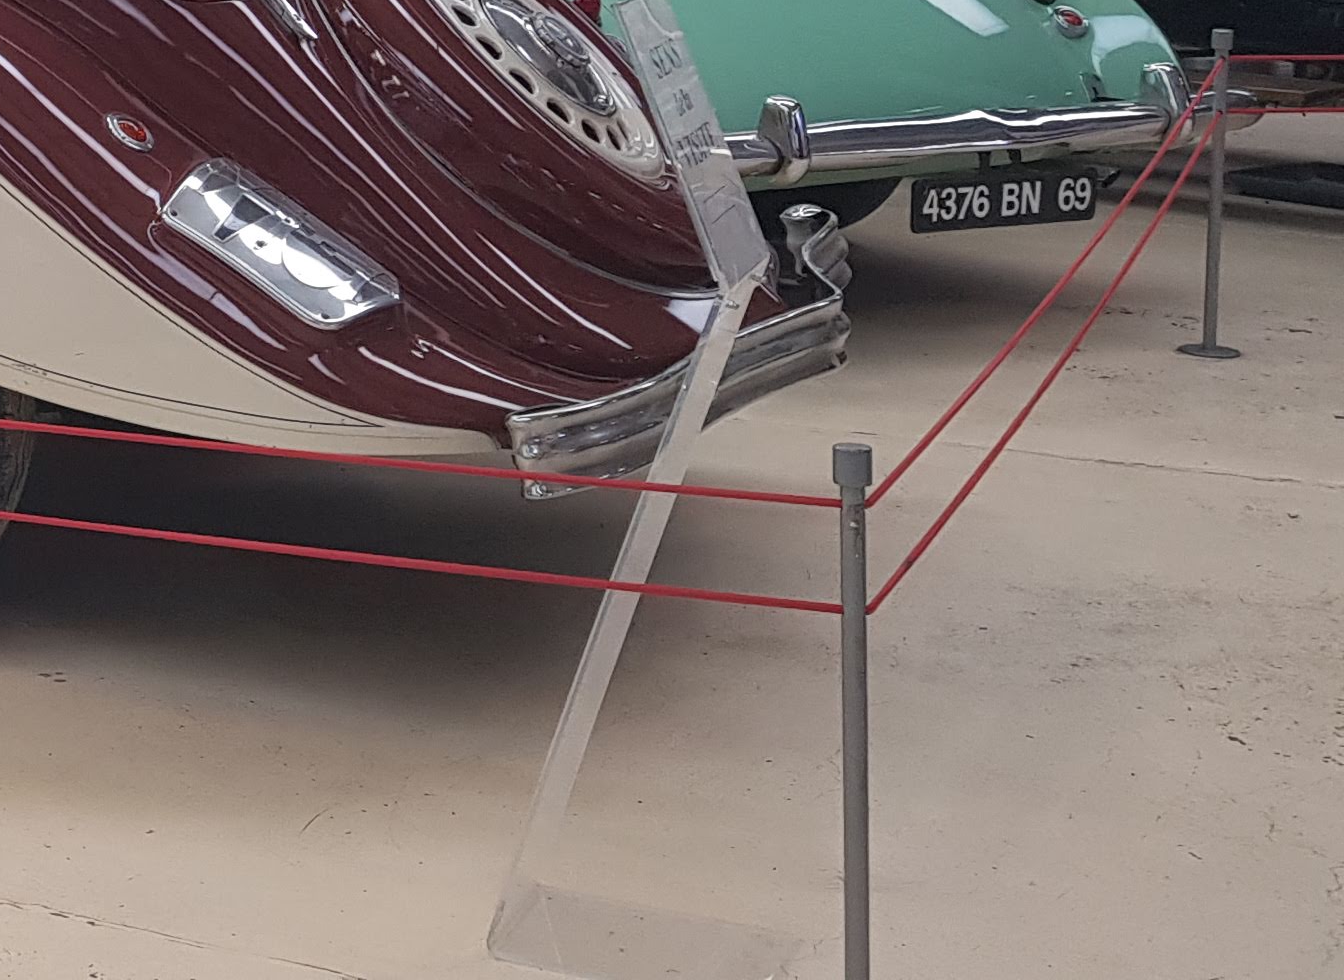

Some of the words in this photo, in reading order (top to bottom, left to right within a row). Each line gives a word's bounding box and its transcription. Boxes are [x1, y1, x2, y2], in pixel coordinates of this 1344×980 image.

[922, 185, 991, 223] 4376
[1000, 181, 1042, 217] BN
[1057, 177, 1092, 212] 69
